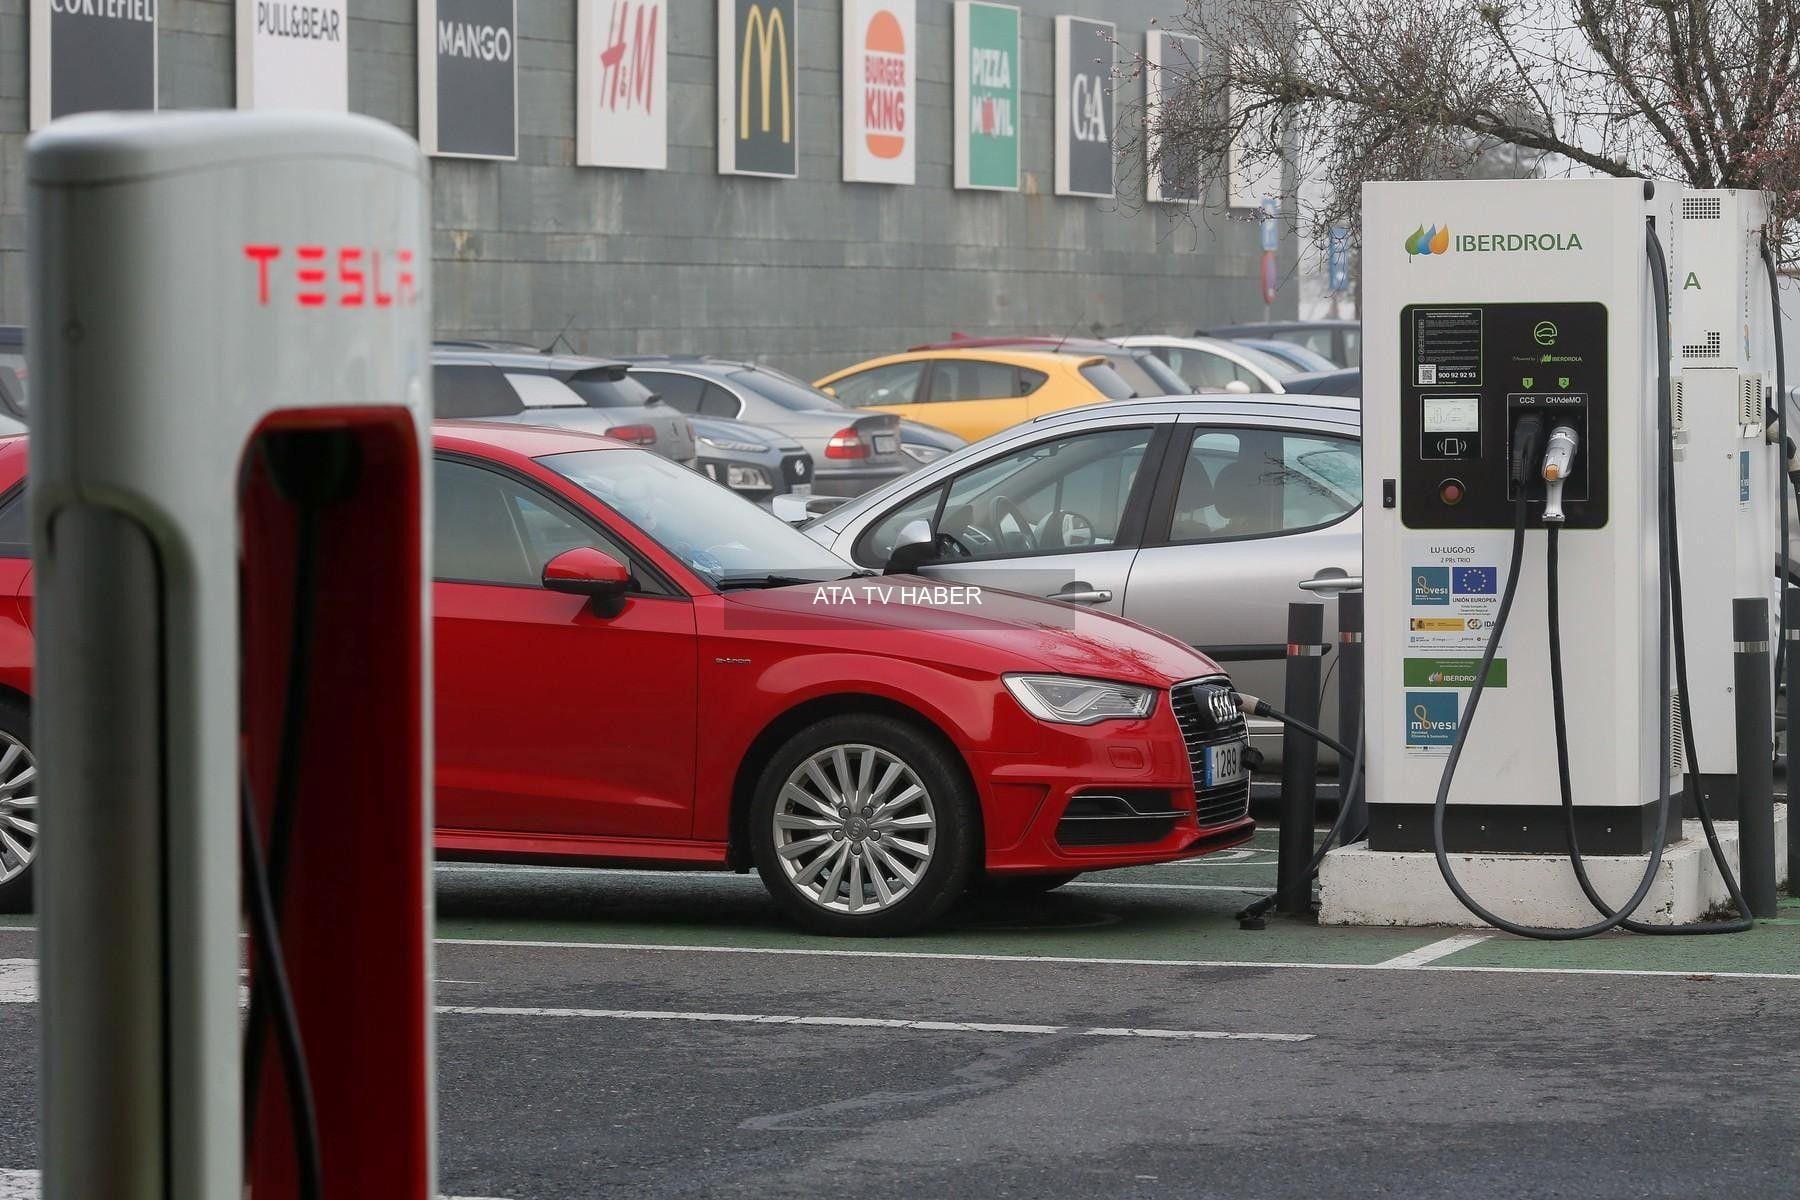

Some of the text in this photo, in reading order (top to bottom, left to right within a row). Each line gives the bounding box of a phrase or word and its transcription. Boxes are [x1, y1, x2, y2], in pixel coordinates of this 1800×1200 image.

[258, 2, 340, 41] PULL&BEAR
[438, 20, 511, 62] MANGO
[600, 1, 658, 115] H&M
[865, 55, 905, 87] BURGER
[972, 47, 1011, 89] PIZZA
[865, 88, 905, 132] KING
[1072, 73, 1107, 143] C&A
[1455, 233, 1583, 251] IBERDROLA
[1519, 396, 1536, 404] CCS
[1430, 546, 1475, 554] LU-LUGO-05
[1484, 620, 1495, 628] IDA
[1215, 747, 1237, 779] 1289
